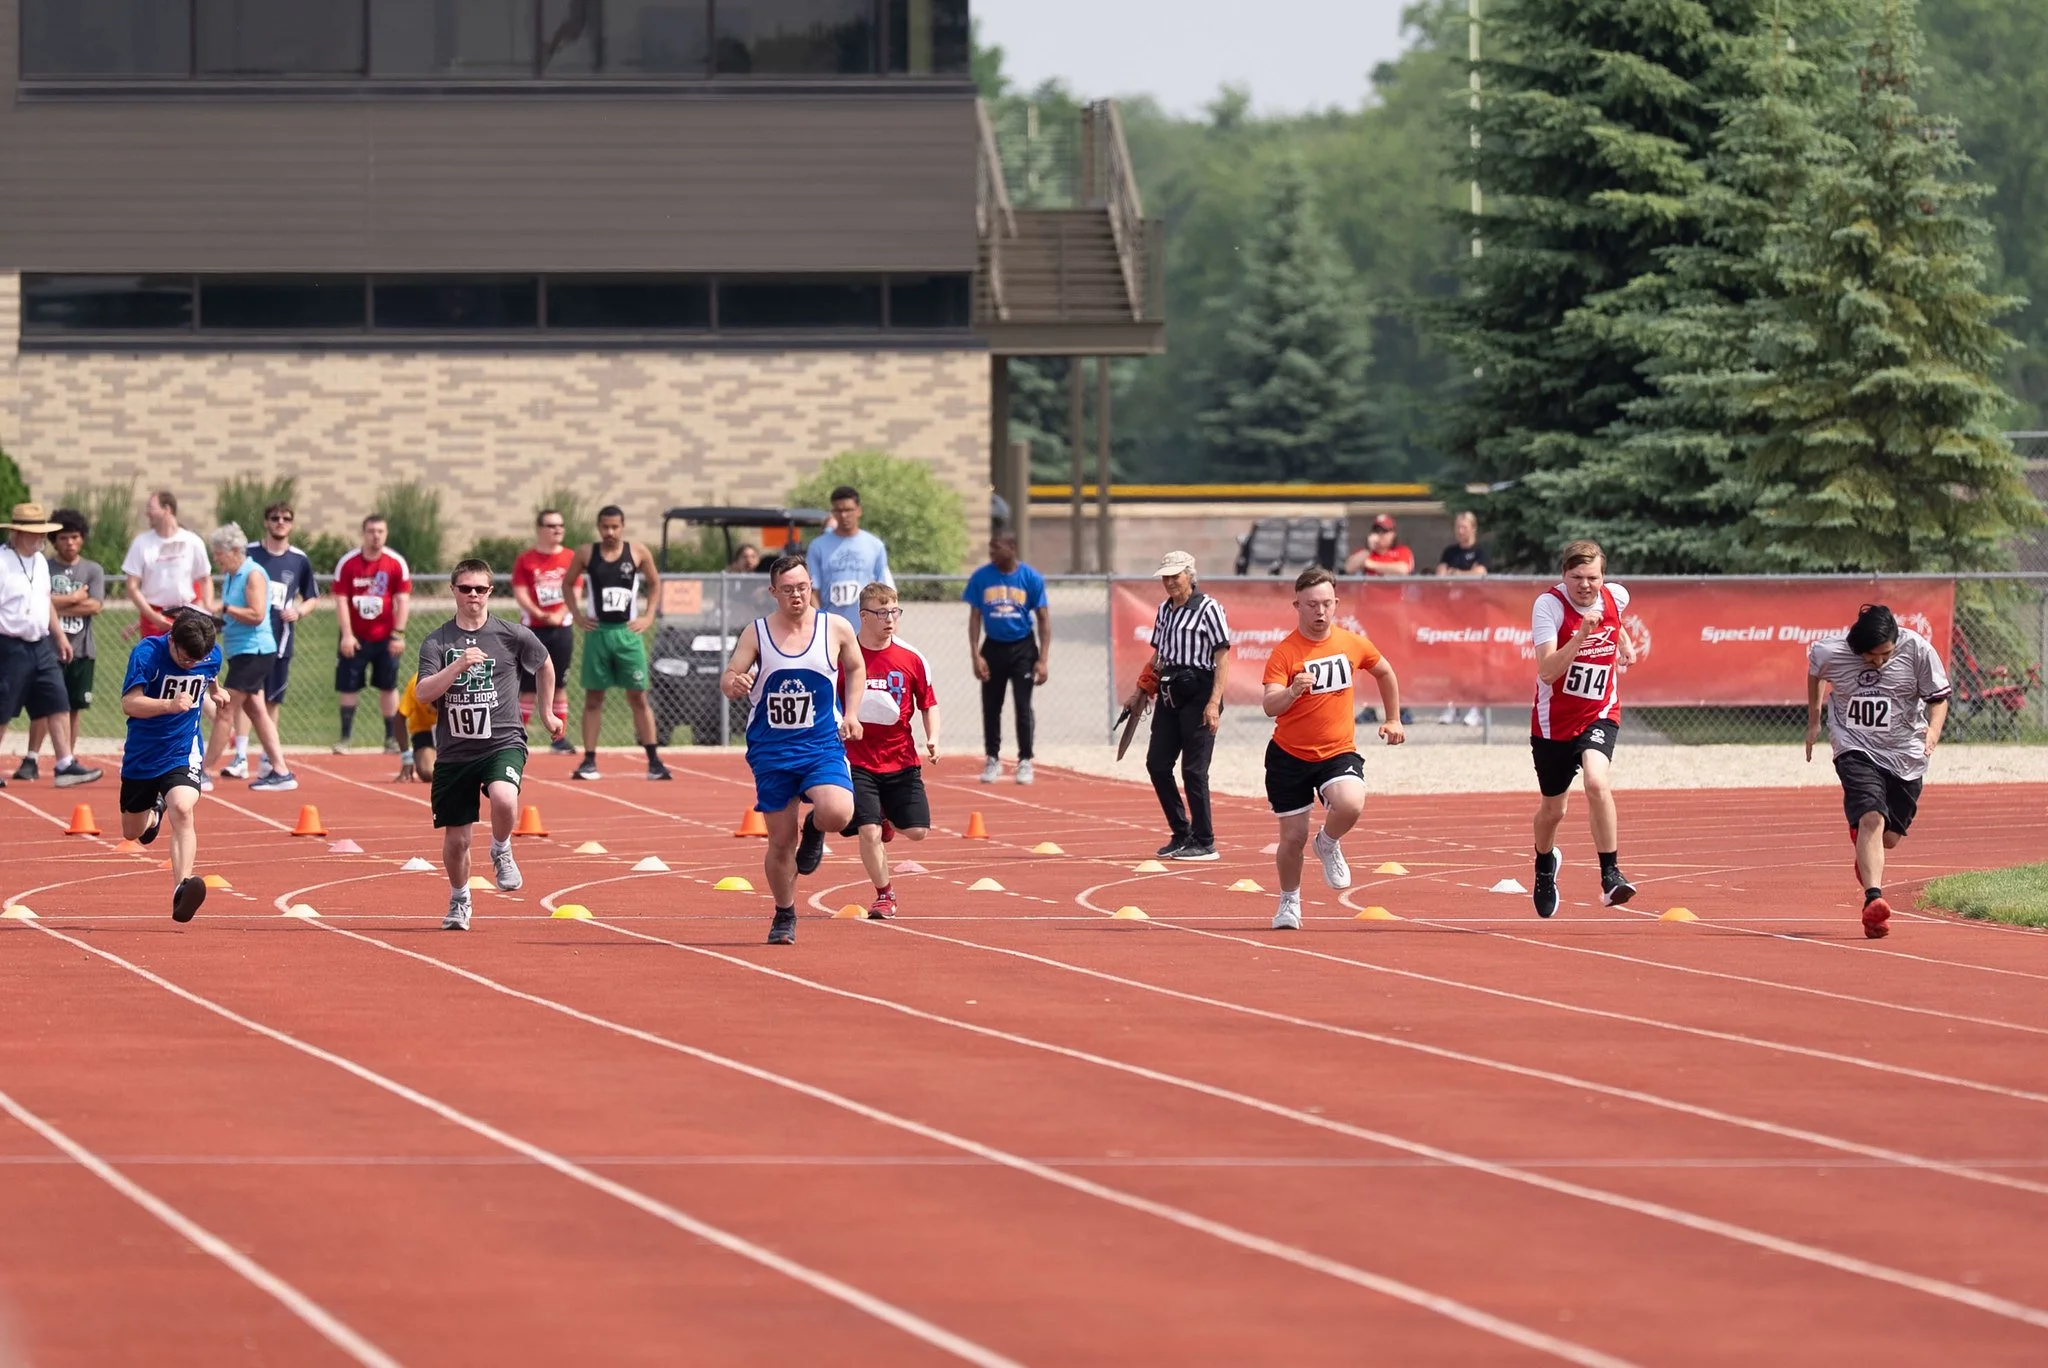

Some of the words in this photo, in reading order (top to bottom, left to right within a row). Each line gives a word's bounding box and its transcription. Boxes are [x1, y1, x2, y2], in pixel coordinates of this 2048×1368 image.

[832, 584, 858, 602] 317
[1416, 626, 1491, 645] Special
[1701, 625, 1774, 644] Special
[1309, 658, 1347, 690] 271
[1566, 665, 1607, 696] 514
[474, 691, 498, 703] HOPP
[769, 695, 810, 725] 587
[450, 707, 487, 735] 197
[1847, 700, 1888, 727] 402
